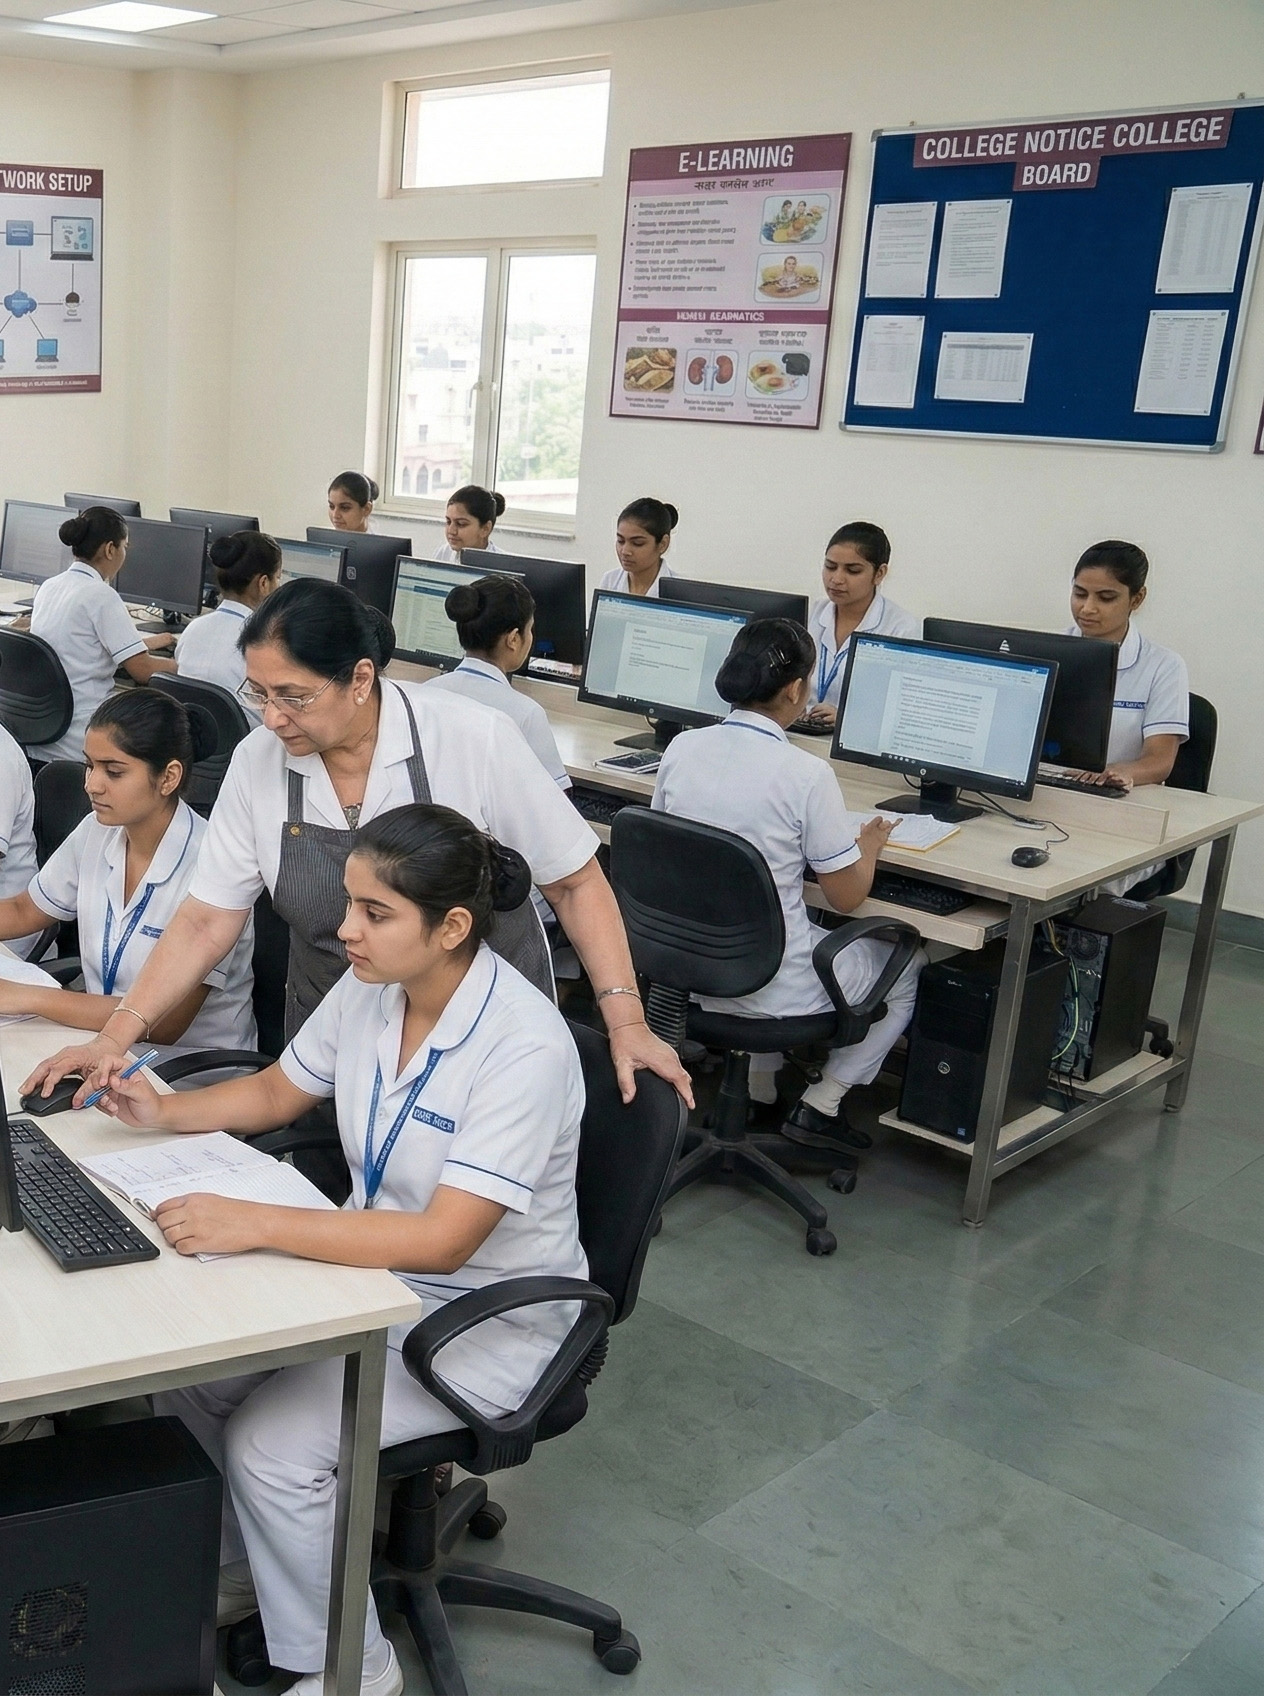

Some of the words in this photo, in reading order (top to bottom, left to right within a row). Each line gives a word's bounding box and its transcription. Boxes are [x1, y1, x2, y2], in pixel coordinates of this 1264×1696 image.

[922, 132, 1018, 160] COLLEGE
[1023, 125, 1107, 154] NOTICE
[1112, 116, 1224, 147] COLLEGE
[678, 144, 794, 173] E-LEARNING
[49, 173, 93, 192] SETUP
[1021, 162, 1092, 186] BOARD
